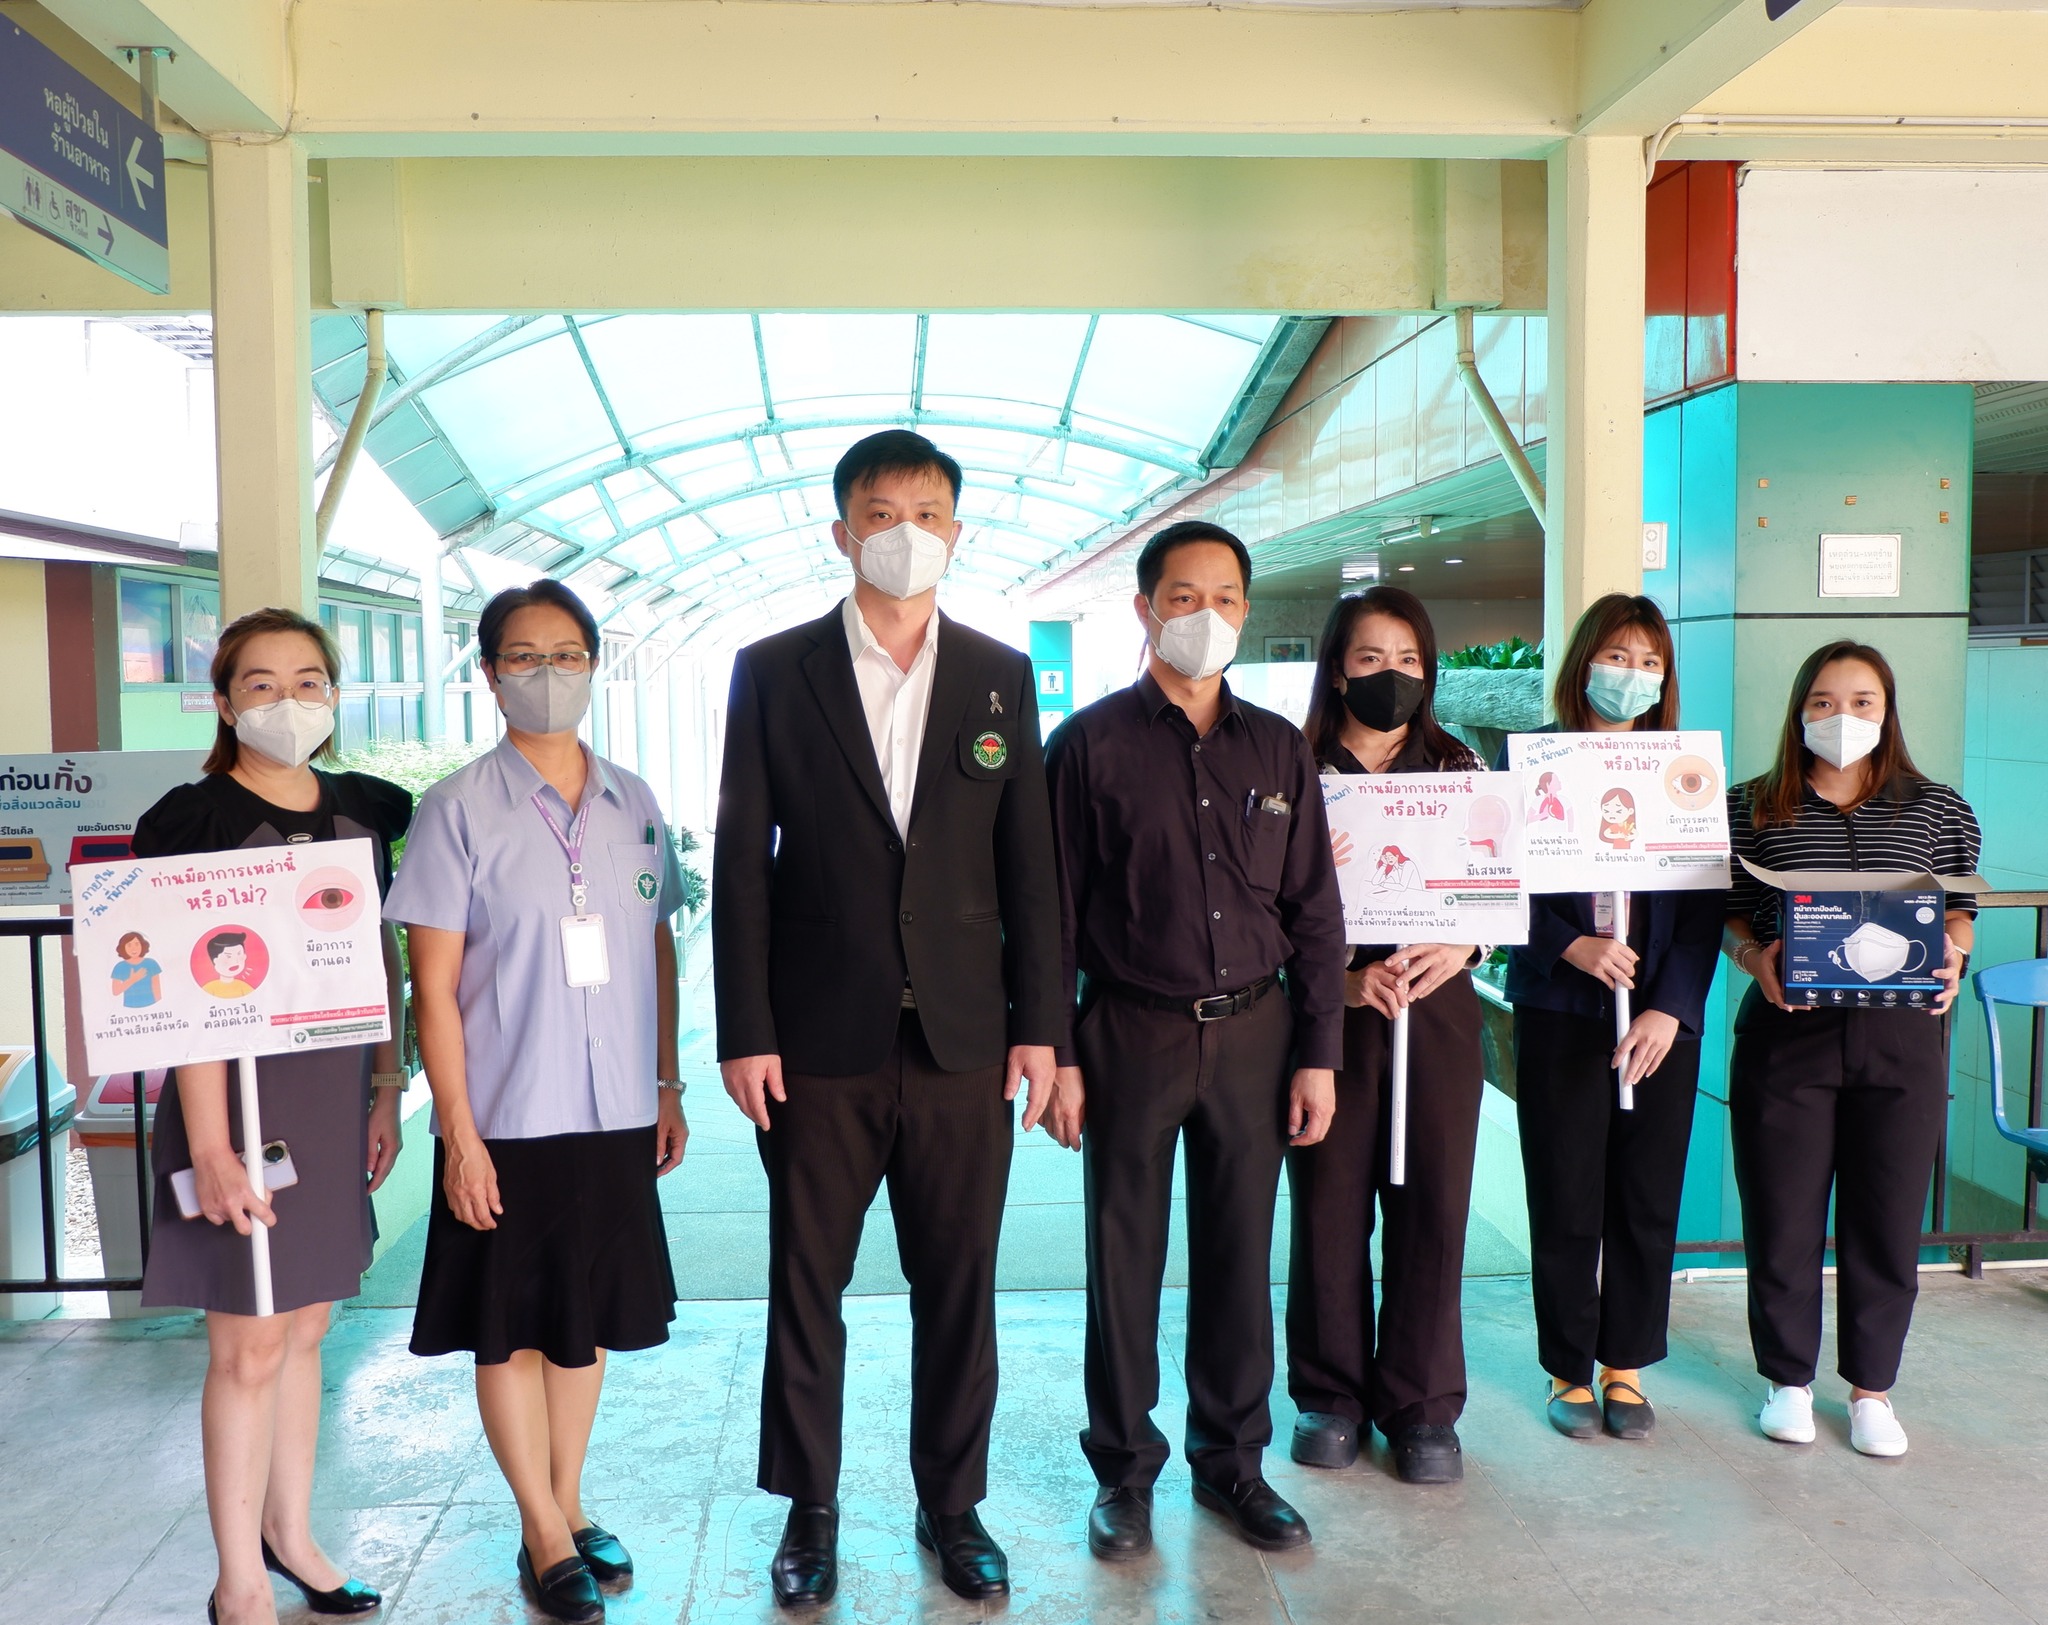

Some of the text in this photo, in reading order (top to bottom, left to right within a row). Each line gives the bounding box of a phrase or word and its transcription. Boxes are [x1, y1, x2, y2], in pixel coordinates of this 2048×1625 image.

[44, 88, 108, 148] หอผู้ป่วยใน
[51, 122, 110, 185] ร้านอาหาร
[1527, 736, 1556, 751] ภายใน
[1580, 736, 1682, 750] ท่านมีอาการเหล่านี้
[1527, 757, 1539, 766] วัน
[1604, 756, 1660, 773] หรือไม่?
[1358, 776, 1473, 794] ท่านมีอาการเหล่านี้
[1384, 800, 1448, 818] หรือไม่?
[78, 822, 132, 832] ขยะอันตราย
[1670, 816, 1718, 825] มีการระคาย
[1530, 836, 1579, 846] แน่นหน้าอก
[1528, 847, 1582, 857] หายใจลำบาก
[150, 852, 296, 888] ท่านมีอาการเหล่านี้
[1467, 864, 1512, 876] มีเสมหะ
[81, 868, 114, 901] ภายใน
[186, 884, 268, 910] หรือไม่?
[1794, 895, 1812, 904] 3M
[82, 918, 90, 927] 7
[90, 903, 108, 918] วัน
[1363, 906, 1435, 916] มีอาการเหนื่อยมาก
[1794, 912, 1852, 921] ฝุ่นละอองขนาดเล็ก
[307, 940, 352, 952] มีอาการ
[312, 956, 350, 966] ตาแดง
[110, 1010, 172, 1025] มีอาการหอบ
[204, 1014, 264, 1029] ตลอดเวลา
[96, 1020, 190, 1040] หายใจเสียงดังหวีด
